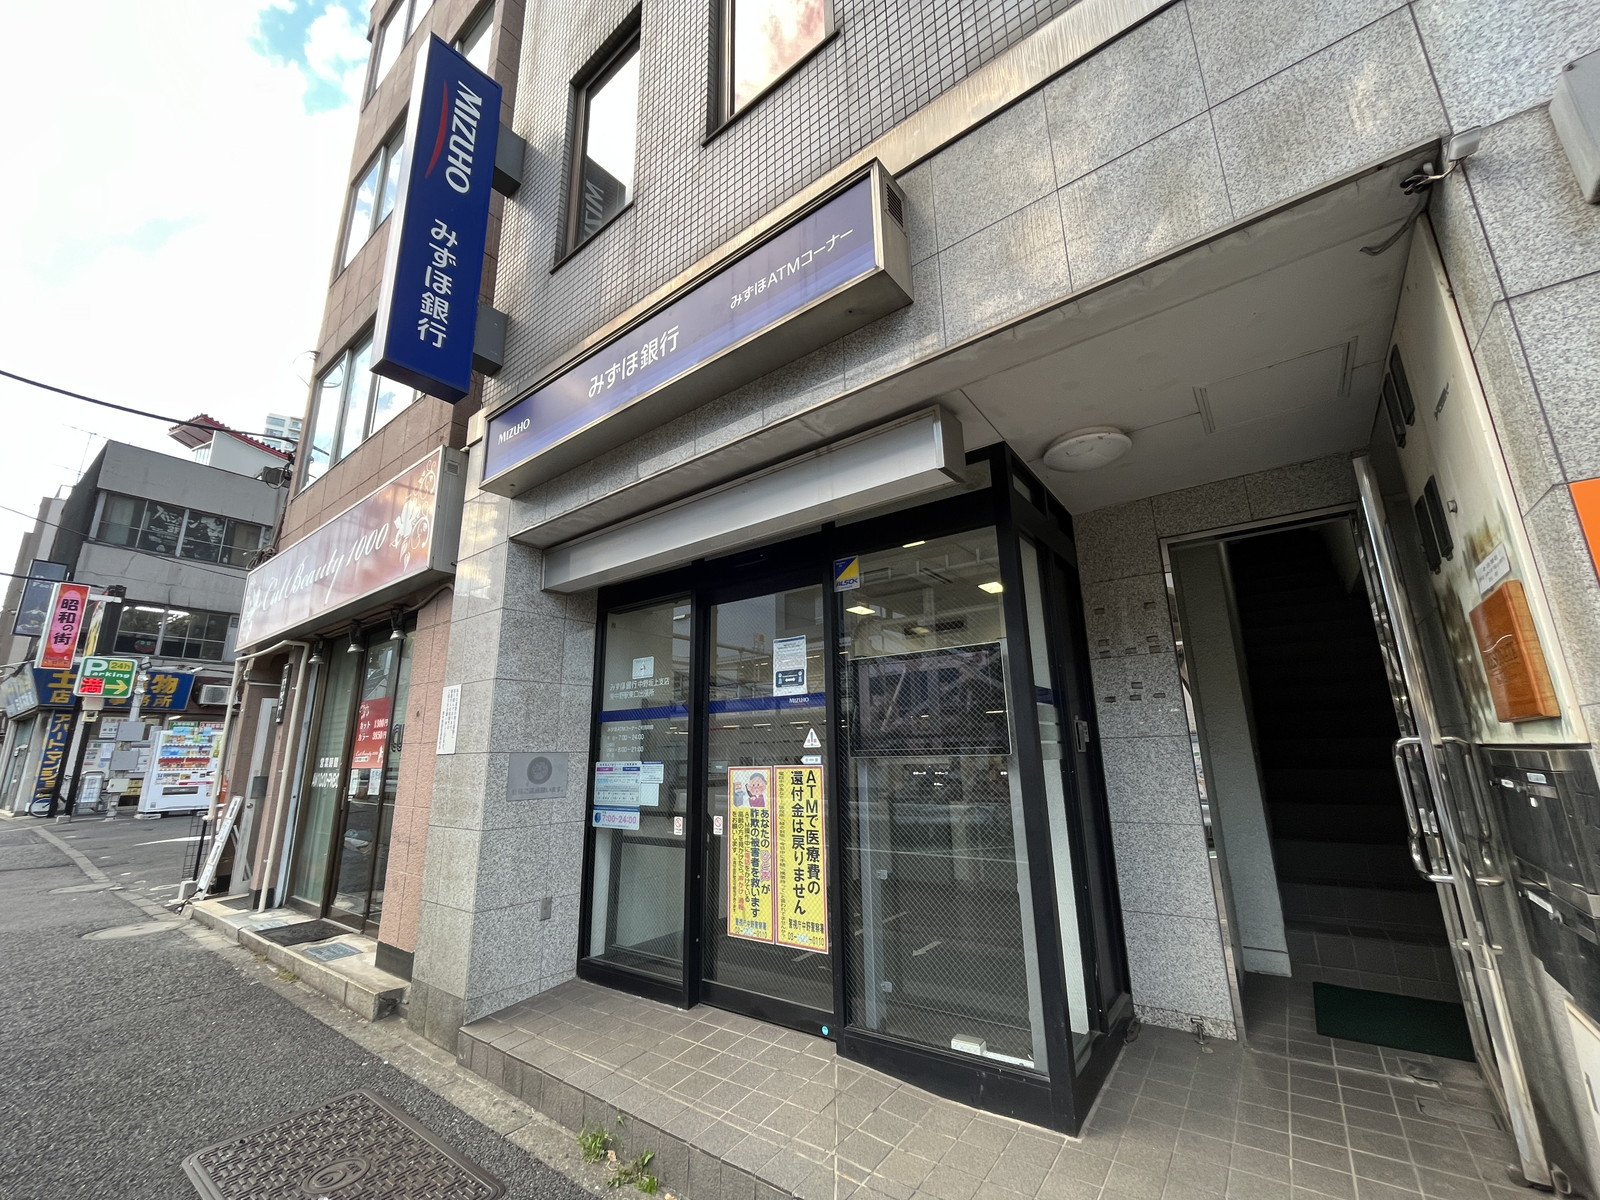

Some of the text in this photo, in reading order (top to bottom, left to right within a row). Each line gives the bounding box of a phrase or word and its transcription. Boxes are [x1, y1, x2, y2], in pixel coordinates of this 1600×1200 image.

[445, 80, 482, 194] MIZUHO
[417, 218, 458, 349] みずほ銀行
[730, 228, 854, 310] みずほATMコーナー
[588, 324, 680, 399] みずほ銀行
[497, 418, 531, 446] MIZUHO
[346, 522, 390, 566] 1000
[835, 578, 858, 588] ALSOK
[53, 598, 80, 646] 昭和の街
[83, 659, 131, 679] Parking
[110, 661, 131, 670] 24h
[750, 808, 760, 918] 詐欺の被害者を救います
[790, 770, 806, 915] 還付金は戻りません
[805, 769, 821, 896] ATMで医療費の
